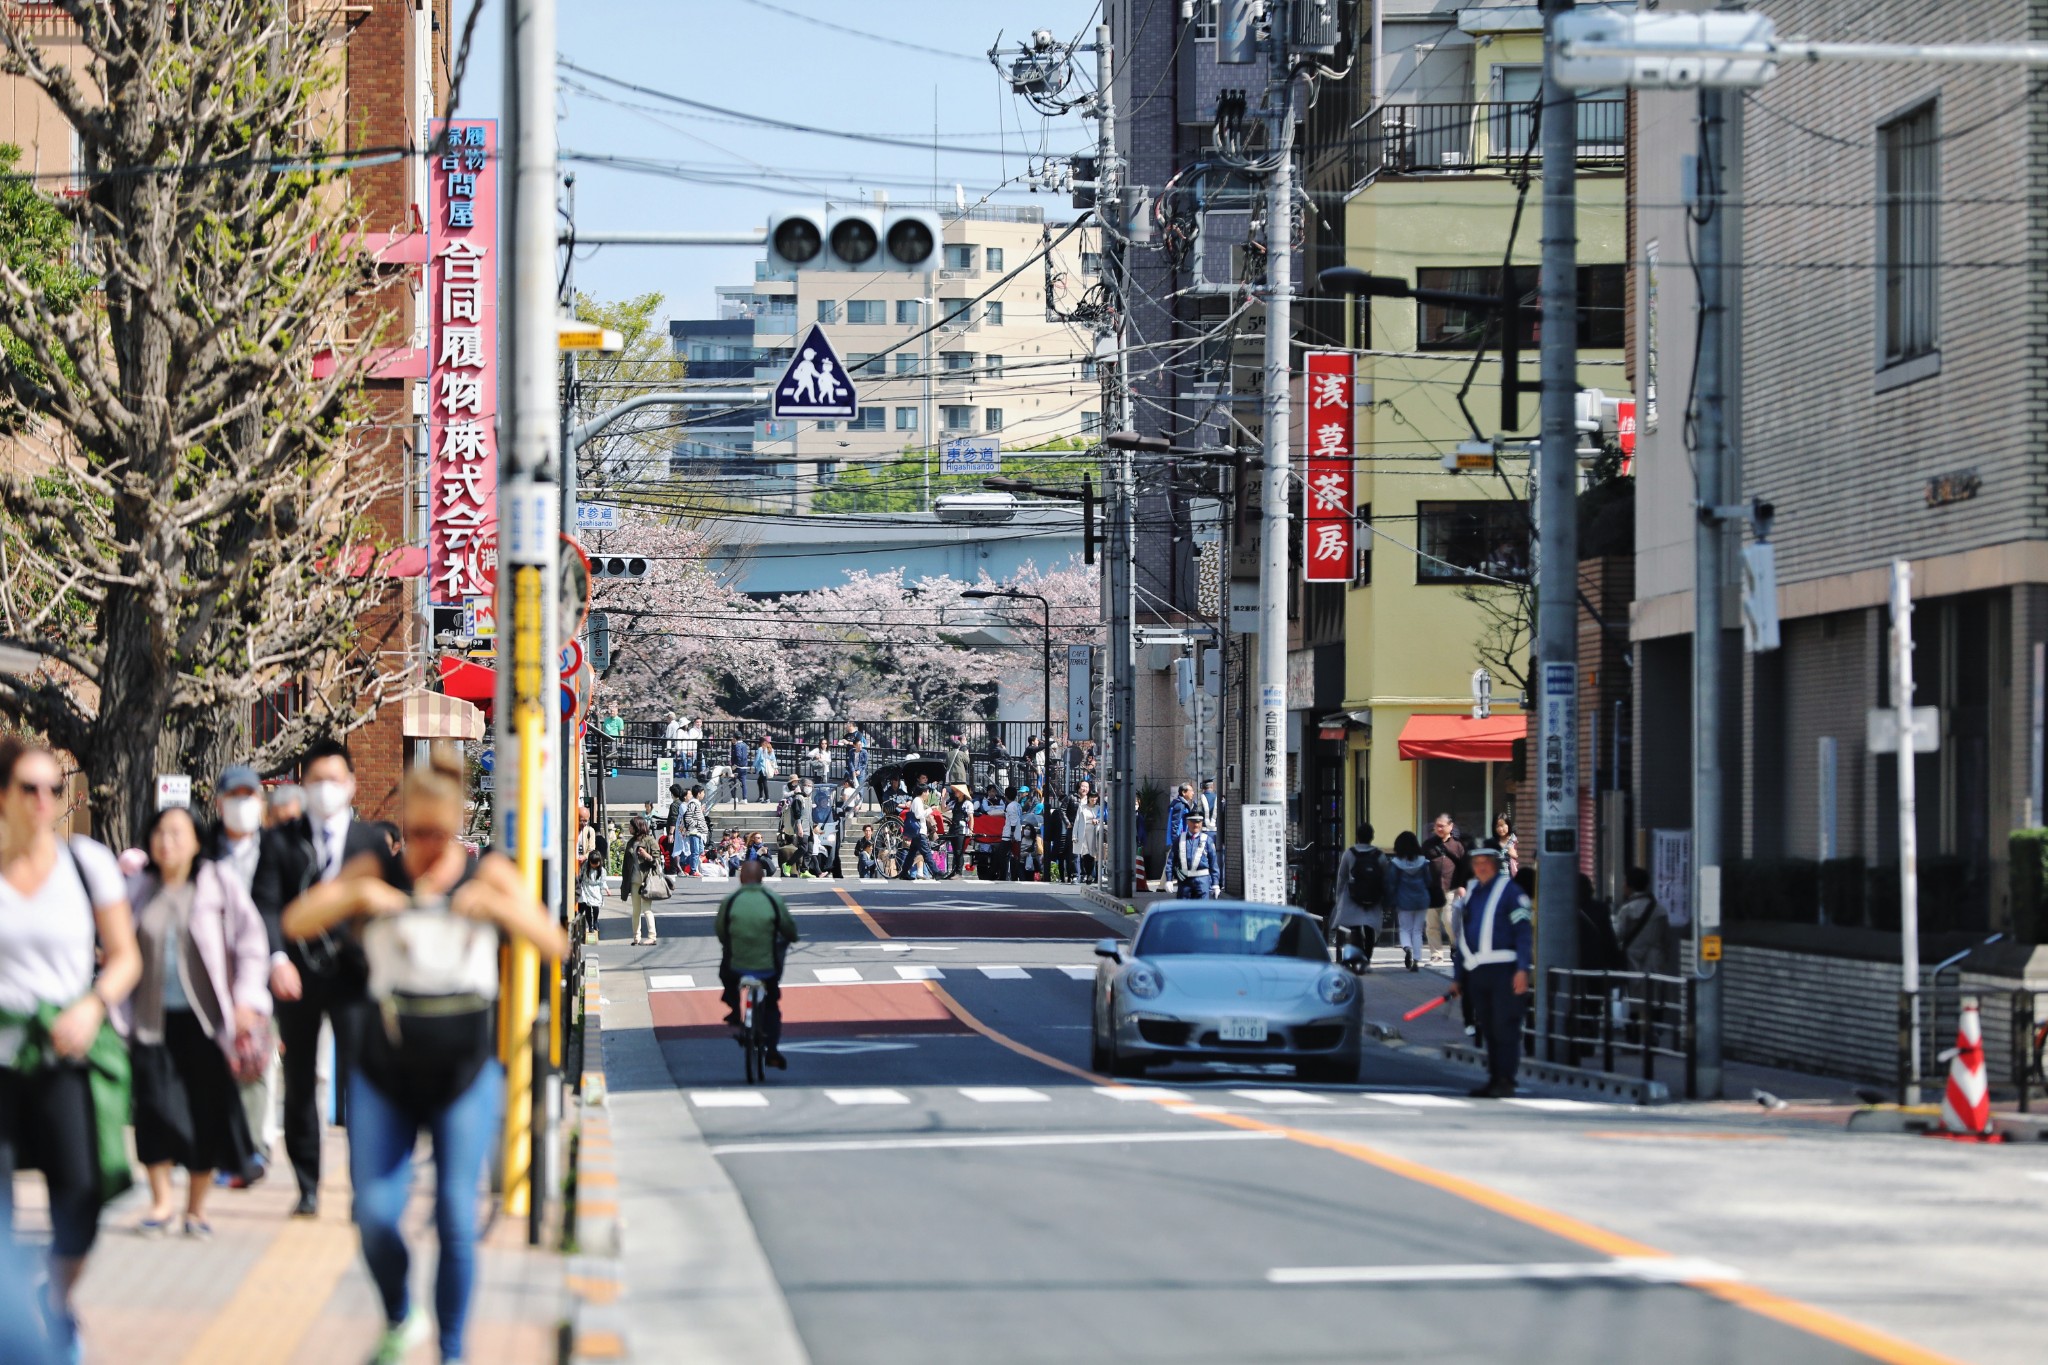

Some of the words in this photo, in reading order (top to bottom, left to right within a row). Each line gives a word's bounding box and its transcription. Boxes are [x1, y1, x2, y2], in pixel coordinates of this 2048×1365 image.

[465, 126, 486, 170] 履物
[448, 173, 476, 228] 問屋
[437, 240, 488, 597] 合同履物株式会社
[946, 461, 995, 472] Higashisando
[947, 447, 993, 463] 東参道
[1313, 373, 1349, 561] 浅草茶房
[1250, 808, 1277, 817] お願い
